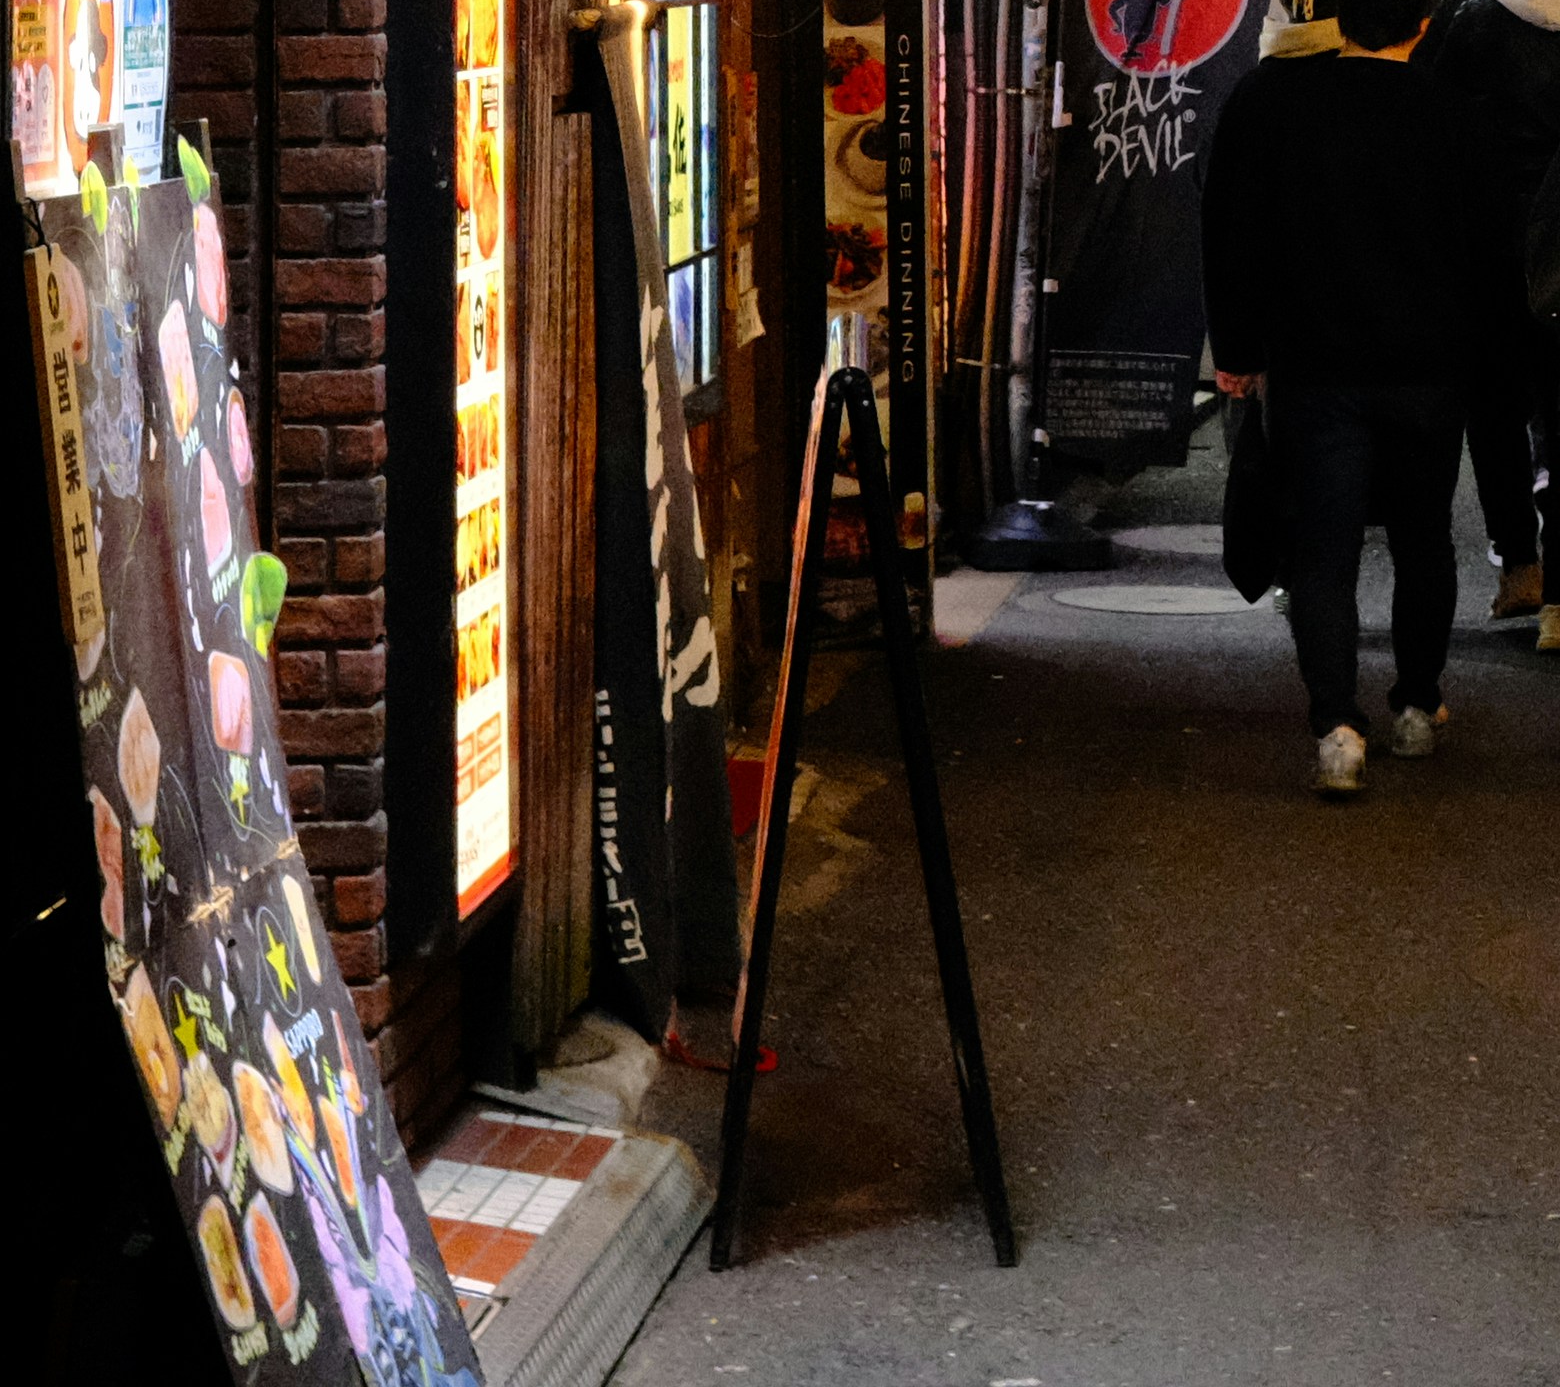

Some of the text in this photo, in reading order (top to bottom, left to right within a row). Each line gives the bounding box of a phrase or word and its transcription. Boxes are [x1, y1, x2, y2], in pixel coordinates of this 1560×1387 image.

[896, 33, 921, 385] CHINESE DINNING
[1088, 60, 1203, 131] BLACK
[53, 346, 95, 576] 営業中
